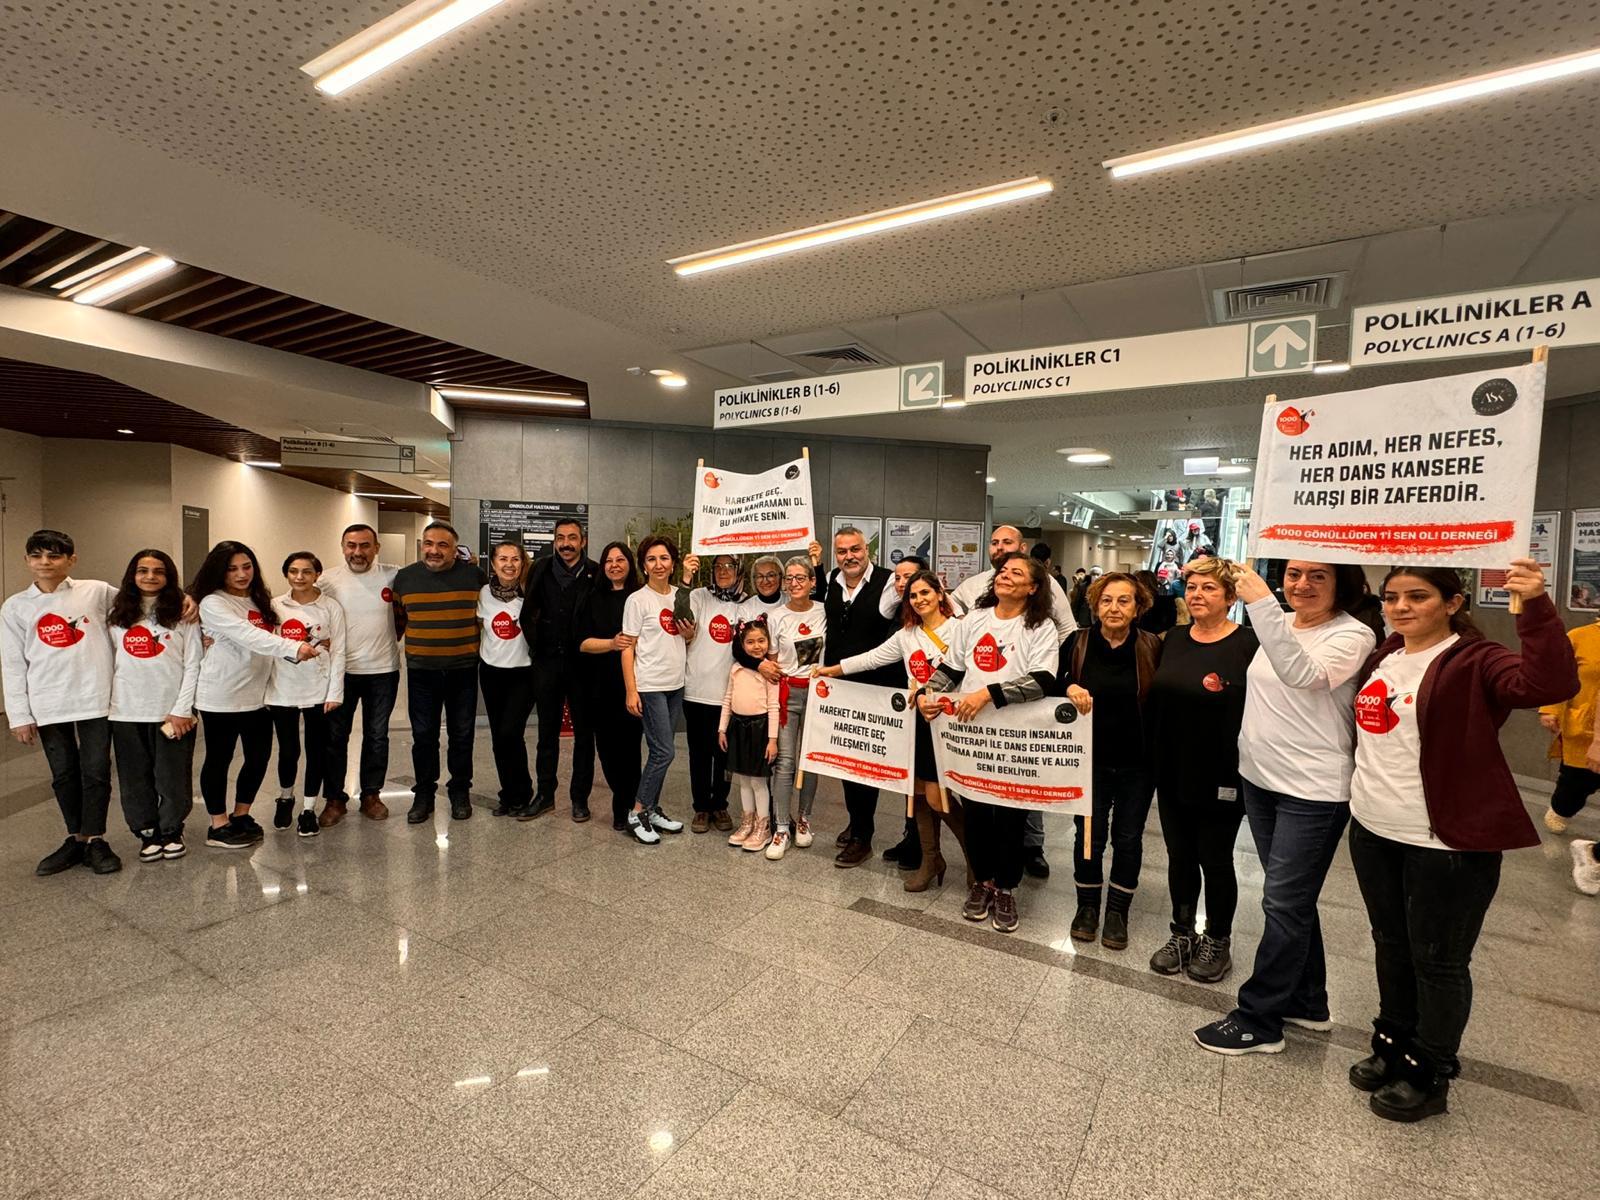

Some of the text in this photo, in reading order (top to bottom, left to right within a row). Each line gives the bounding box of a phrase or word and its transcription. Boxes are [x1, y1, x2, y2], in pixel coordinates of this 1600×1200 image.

[1364, 290, 1592, 332] POLİKLİNİKLER A
[1363, 321, 1566, 355] POLYCLINICS A (1-6)
[973, 348, 1121, 377] POLİKLİNİKLER C1
[719, 381, 841, 407] POLİKLİNİKLER B (1-6)
[973, 375, 1071, 395] POLYCLINICS C1
[719, 405, 802, 421] POLYCLINICS B (1-6)
[1289, 427, 1504, 461] HER ADIM, HER NEFES,
[1300, 456, 1485, 484] HER DANS KANSERE
[725, 487, 783, 505] HAREKETE GEÇ.
[1293, 481, 1486, 510] KARŞI BİR ZAFERDİR.
[702, 497, 807, 516] HAYATININ KAHRAMANI OL.
[719, 511, 790, 527] BU HİKAYE SENİN.
[1275, 528, 1301, 538] 1000
[1304, 528, 1377, 540] GÖNÜLLÜDEN
[1393, 531, 1417, 540] SEN
[1419, 530, 1439, 540] OL!
[1441, 528, 1498, 540] DERNEĞİ
[40, 624, 64, 633] 1000
[976, 645, 994, 653] 1000
[1357, 695, 1380, 705] 1000
[819, 704, 904, 729] HAREKET CAN SUYUMUZ
[833, 722, 885, 742] HAREKETE GEÇ
[948, 722, 1073, 740] DÜNYADA EN CESUR İNSANLAR
[830, 735, 887, 758] İYİLEŞMEYİ SEÇ
[941, 731, 1086, 754] KEMOTERAPİ İLE DANS EDENLERDİR.
[946, 743, 1080, 769] DURMA ADIM AT. SAHNE VE ALKIŞ
[976, 762, 1040, 778] SENİ BEKLİYOR.
